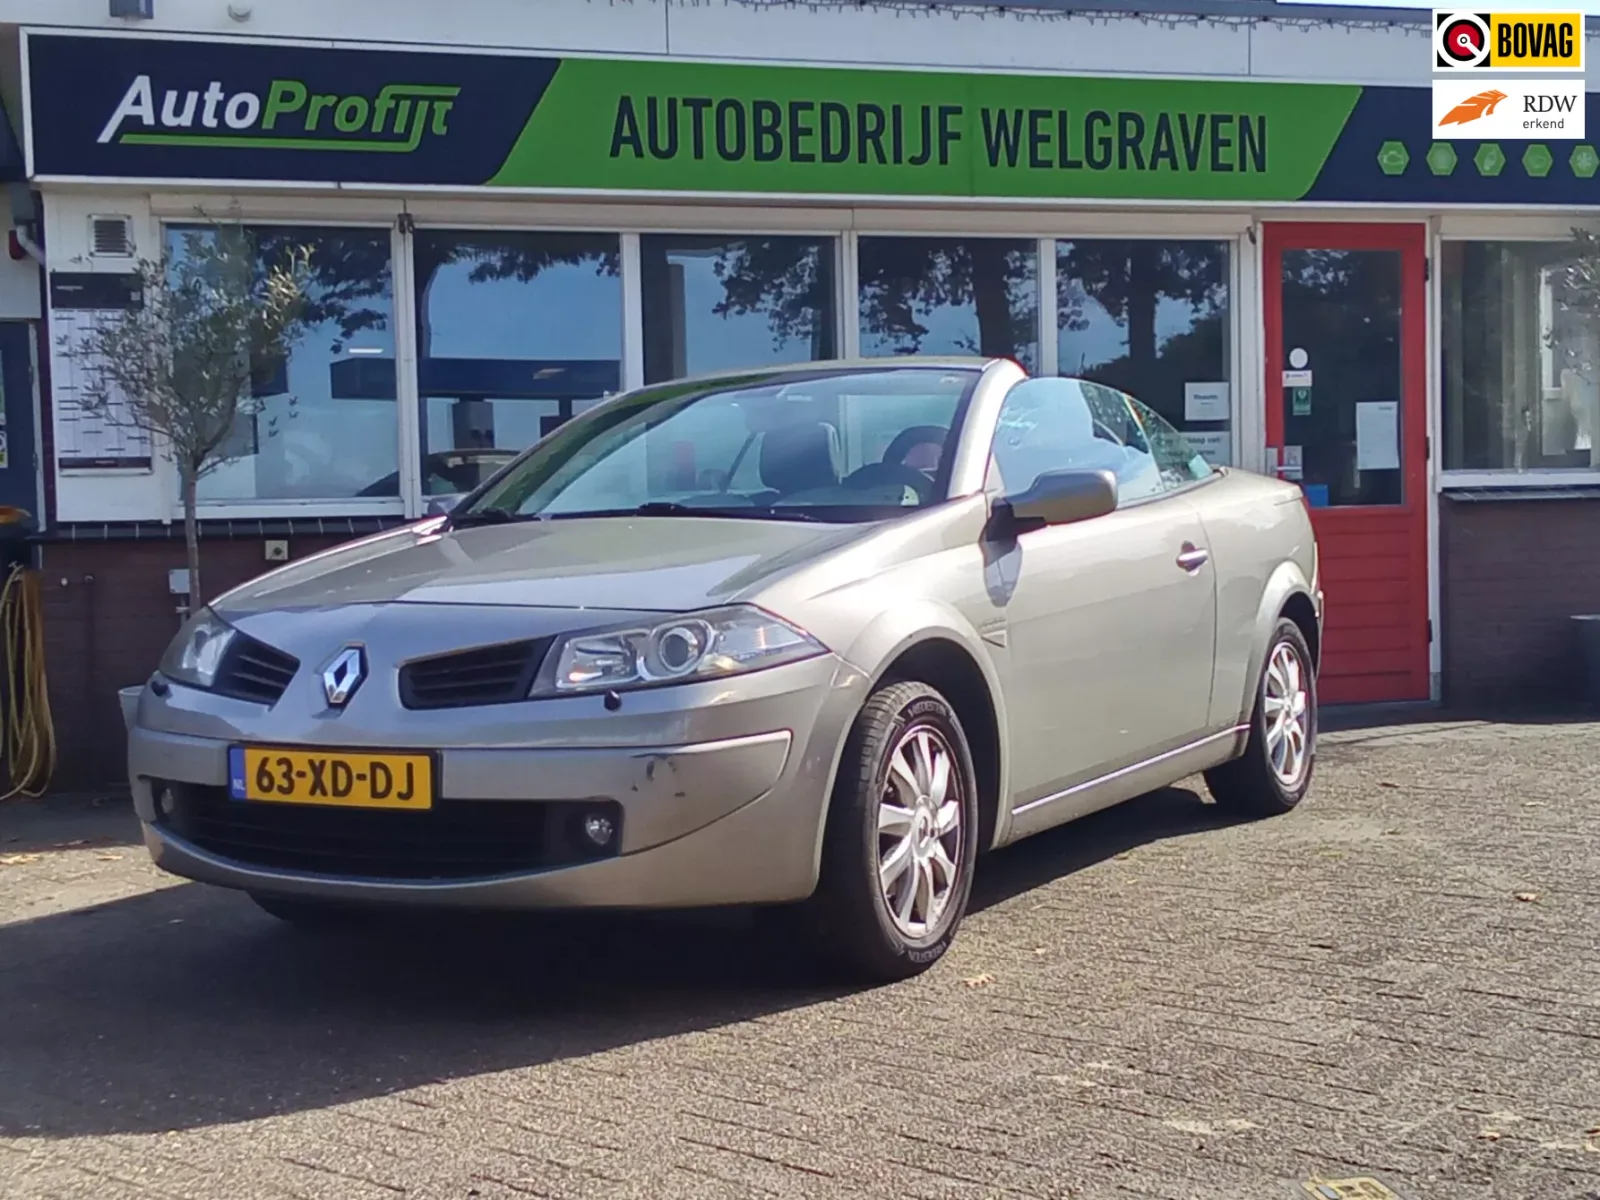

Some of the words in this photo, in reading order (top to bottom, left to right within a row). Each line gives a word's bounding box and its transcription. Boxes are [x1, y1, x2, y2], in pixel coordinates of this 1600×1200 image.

[96, 74, 461, 152] AutoProfijt
[609, 95, 963, 166] AUTOBEDRIJF
[982, 107, 1267, 173] WELGRAVEN
[233, 778, 245, 790] NL
[256, 757, 414, 801] 63-XD-DJ
